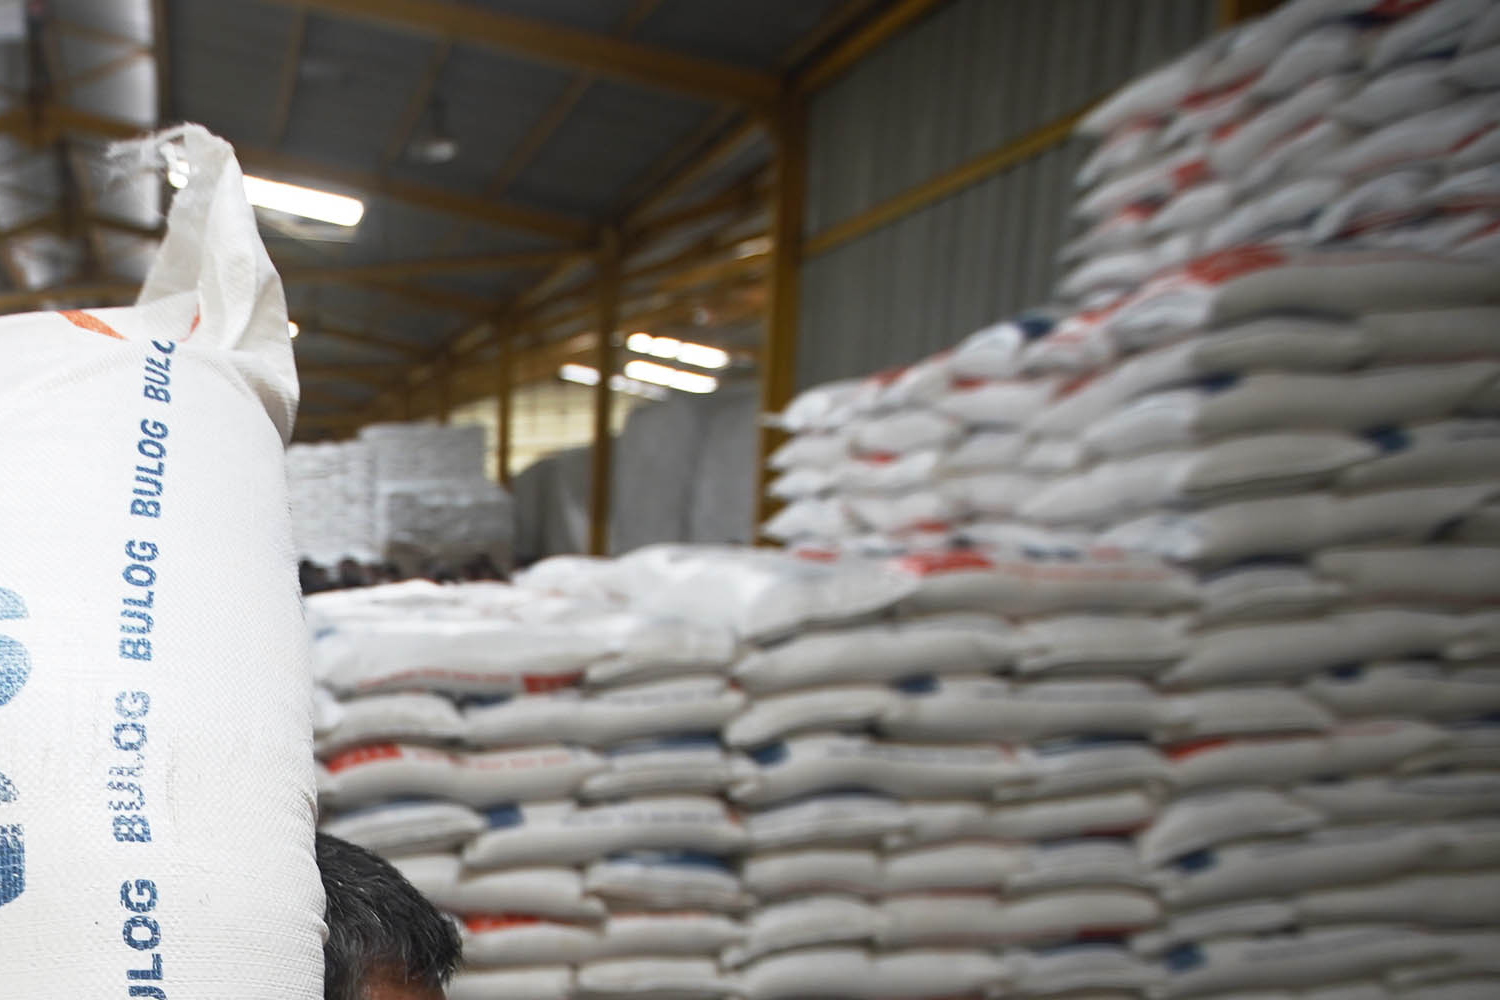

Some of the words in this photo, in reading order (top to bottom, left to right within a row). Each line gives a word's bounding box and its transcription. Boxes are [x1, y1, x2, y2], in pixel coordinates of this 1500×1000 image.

[129, 418, 169, 519] BULOG
[118, 539, 160, 662] BULOG
[108, 690, 153, 844] BULOG
